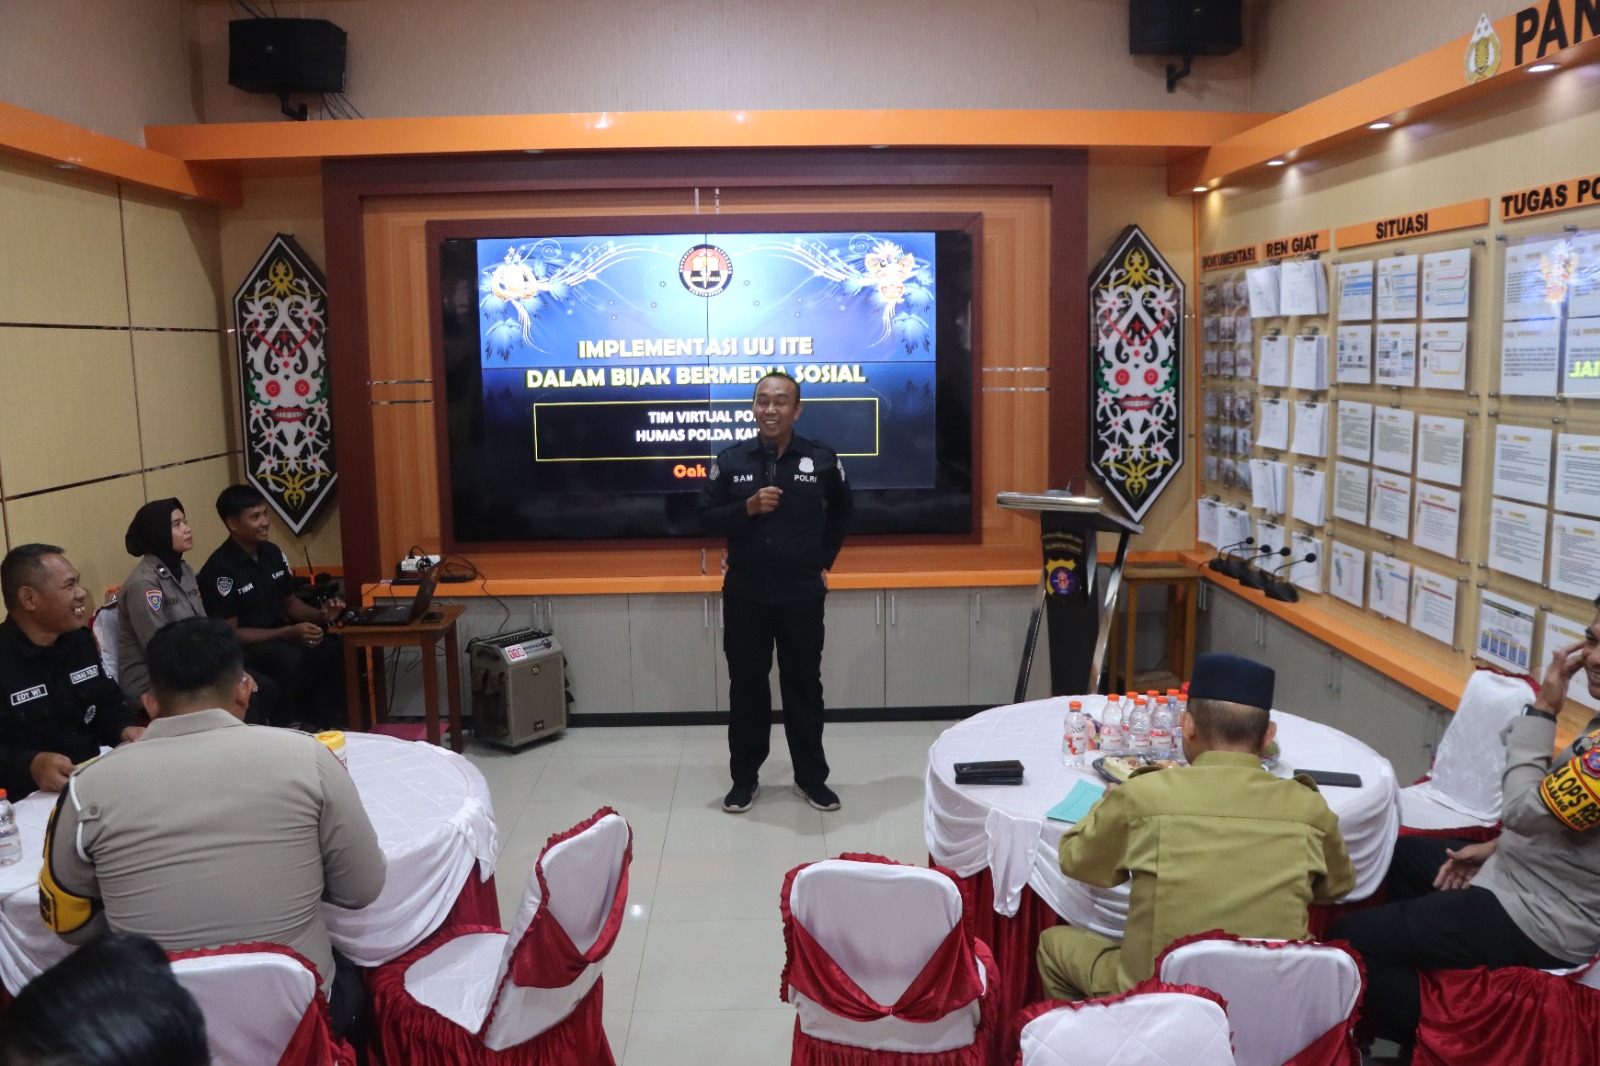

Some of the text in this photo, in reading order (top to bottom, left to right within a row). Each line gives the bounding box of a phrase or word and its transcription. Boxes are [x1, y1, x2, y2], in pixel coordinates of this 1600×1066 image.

[1502, 184, 1568, 217] TUGAS
[1376, 212, 1429, 240] SITUASI
[1266, 234, 1319, 258] REN GIAT
[1202, 247, 1256, 269] DOKUMENTASI
[578, 336, 814, 359] IMPLEMENTASI UU ITE
[525, 368, 606, 388] DALAM
[610, 366, 671, 388] BIJAK
[794, 364, 867, 384] SOSIAL
[647, 409, 757, 424] TIM VIRTUAL PO
[635, 429, 686, 442] HUMAS
[687, 428, 733, 441] POLDA
[733, 474, 754, 483] SAM
[794, 474, 817, 483] POLRI
[16, 691, 30, 702] EDY
[1558, 777, 1589, 807] OPS
